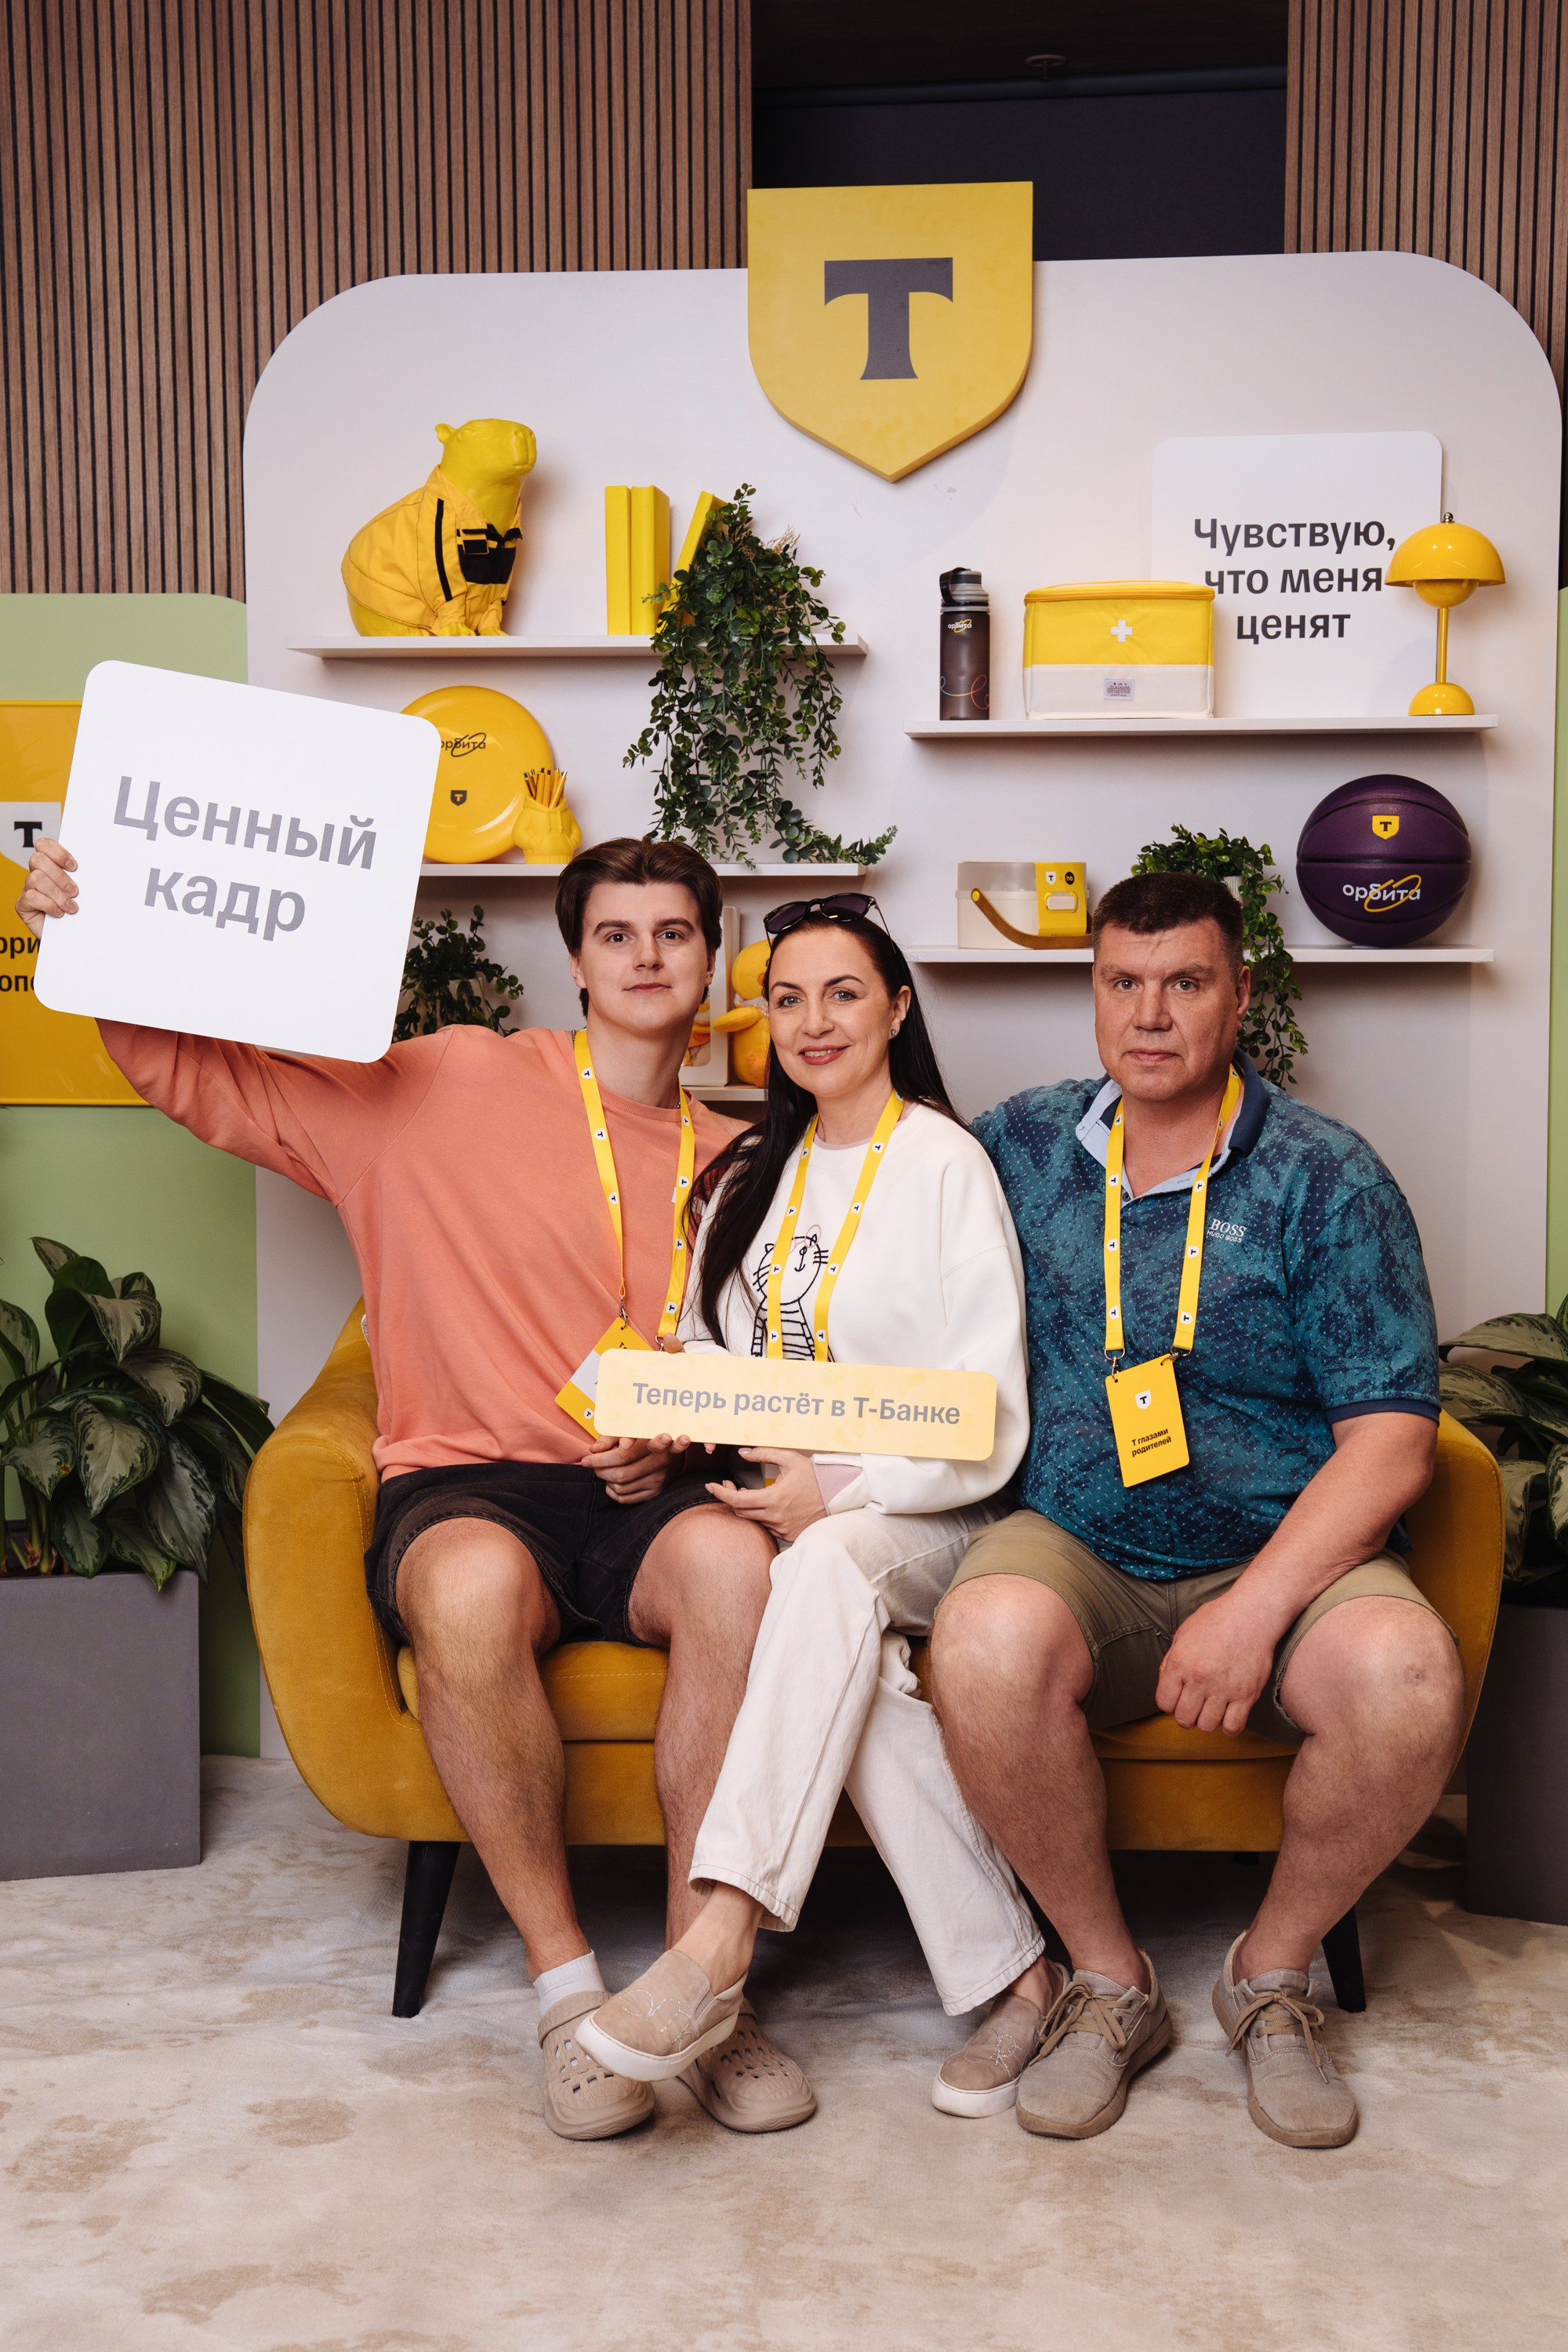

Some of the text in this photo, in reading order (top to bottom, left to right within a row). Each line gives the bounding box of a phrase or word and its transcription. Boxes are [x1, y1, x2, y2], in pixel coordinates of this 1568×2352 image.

[1194, 518, 1396, 557] Чувствую,
[1205, 568, 1382, 594] что меня
[1236, 614, 1351, 644] ценят
[112, 775, 377, 870] Ценный
[1342, 881, 1421, 902] орбита
[143, 866, 307, 942] кадр
[0, 975, 34, 992] оп
[1207, 1229, 1243, 1243] HUGO BOSS
[1209, 1218, 1247, 1237] BOSS
[633, 1382, 960, 1425] Теперь растёт в Т-Банке
[1132, 1436, 1172, 1457] родителей
[1138, 1428, 1169, 1444] глазами
